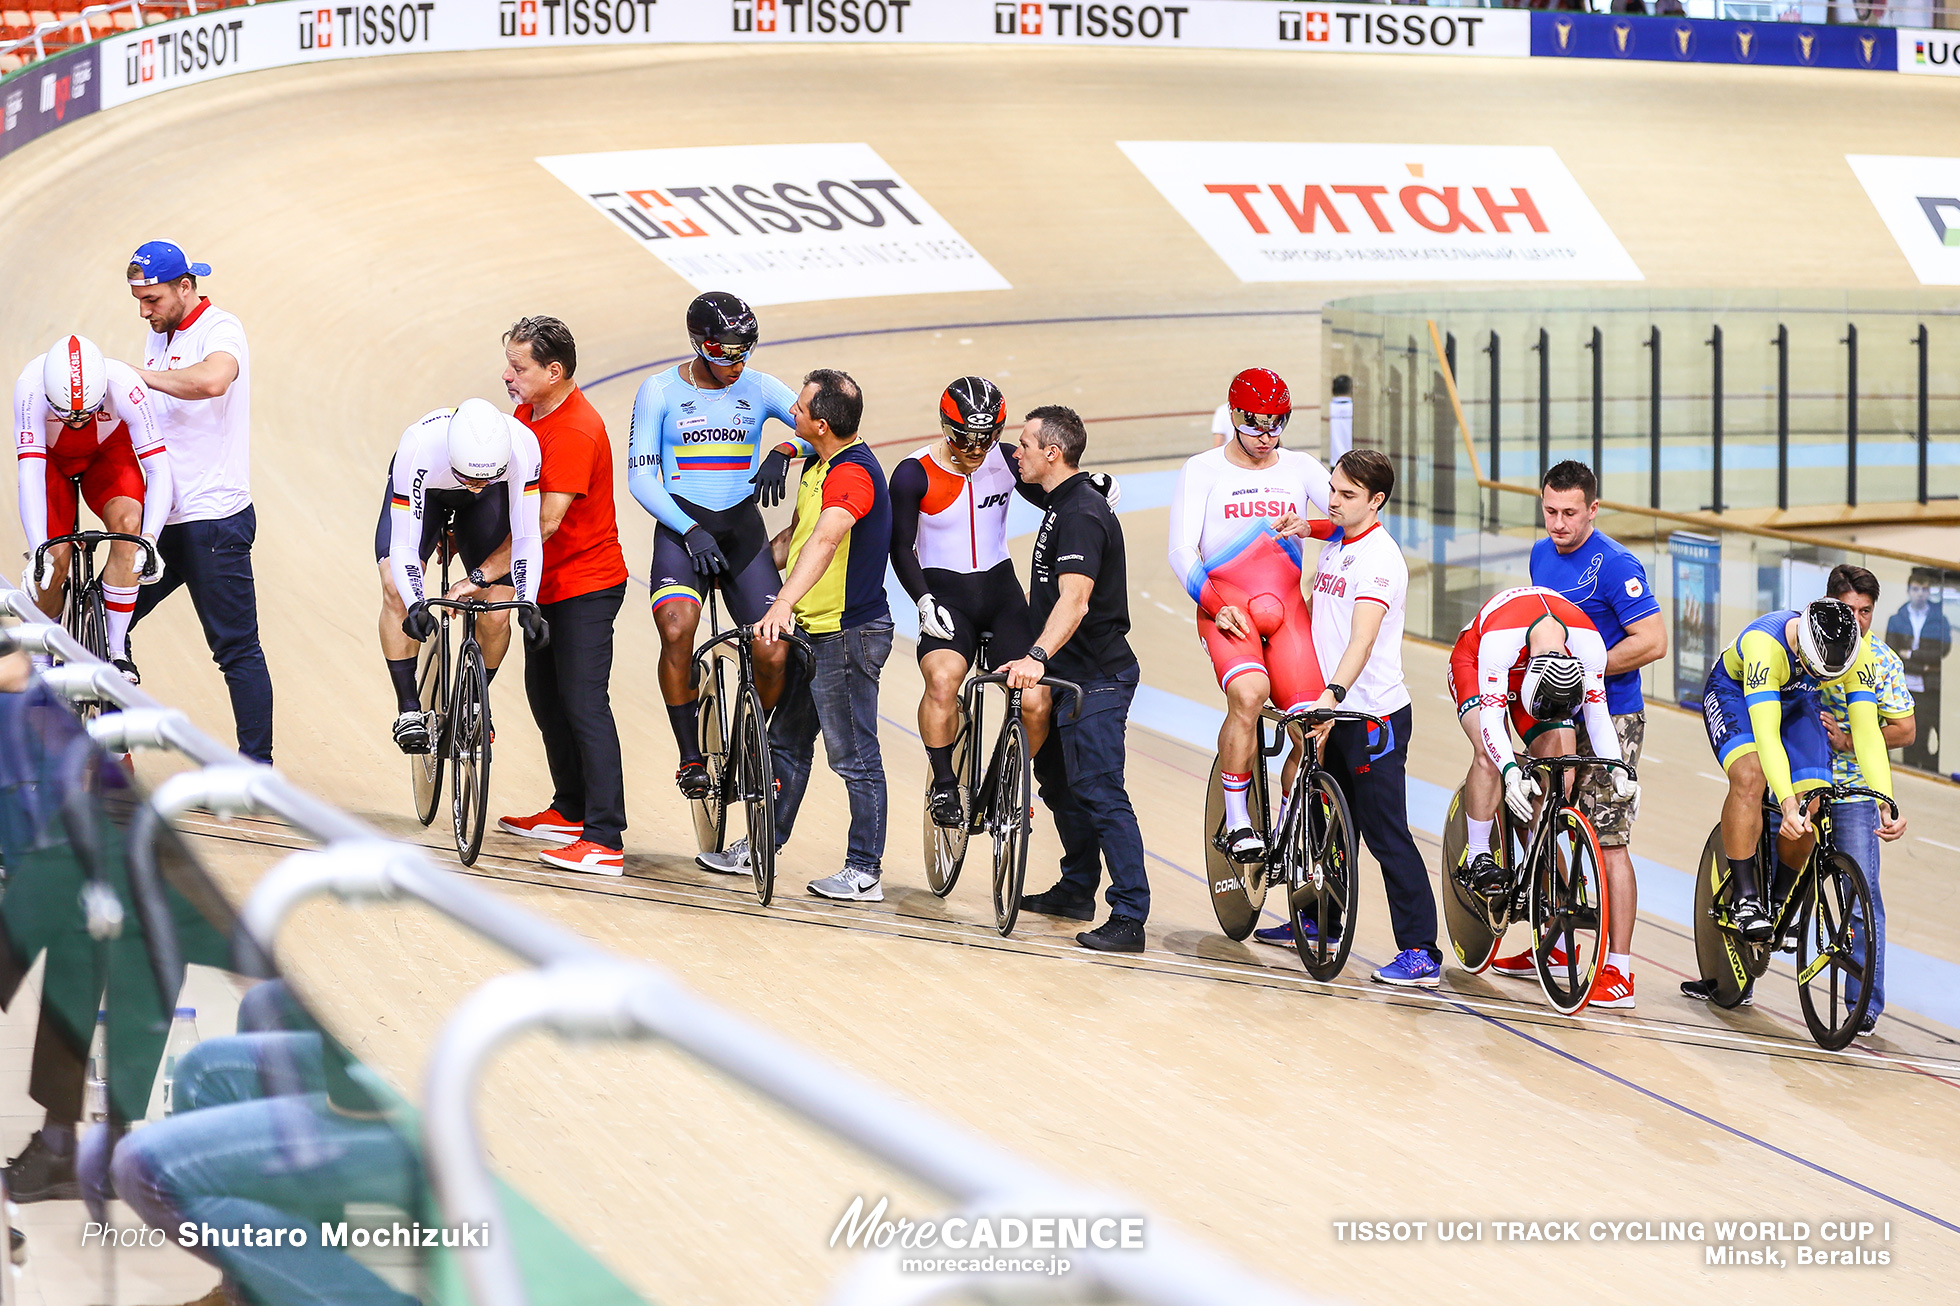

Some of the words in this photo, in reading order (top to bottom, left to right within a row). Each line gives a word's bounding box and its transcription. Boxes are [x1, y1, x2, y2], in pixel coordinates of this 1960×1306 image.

[682, 427, 747, 444] POSTOBON
[412, 468, 429, 520] ŠKODA
[977, 492, 1009, 509] JPC
